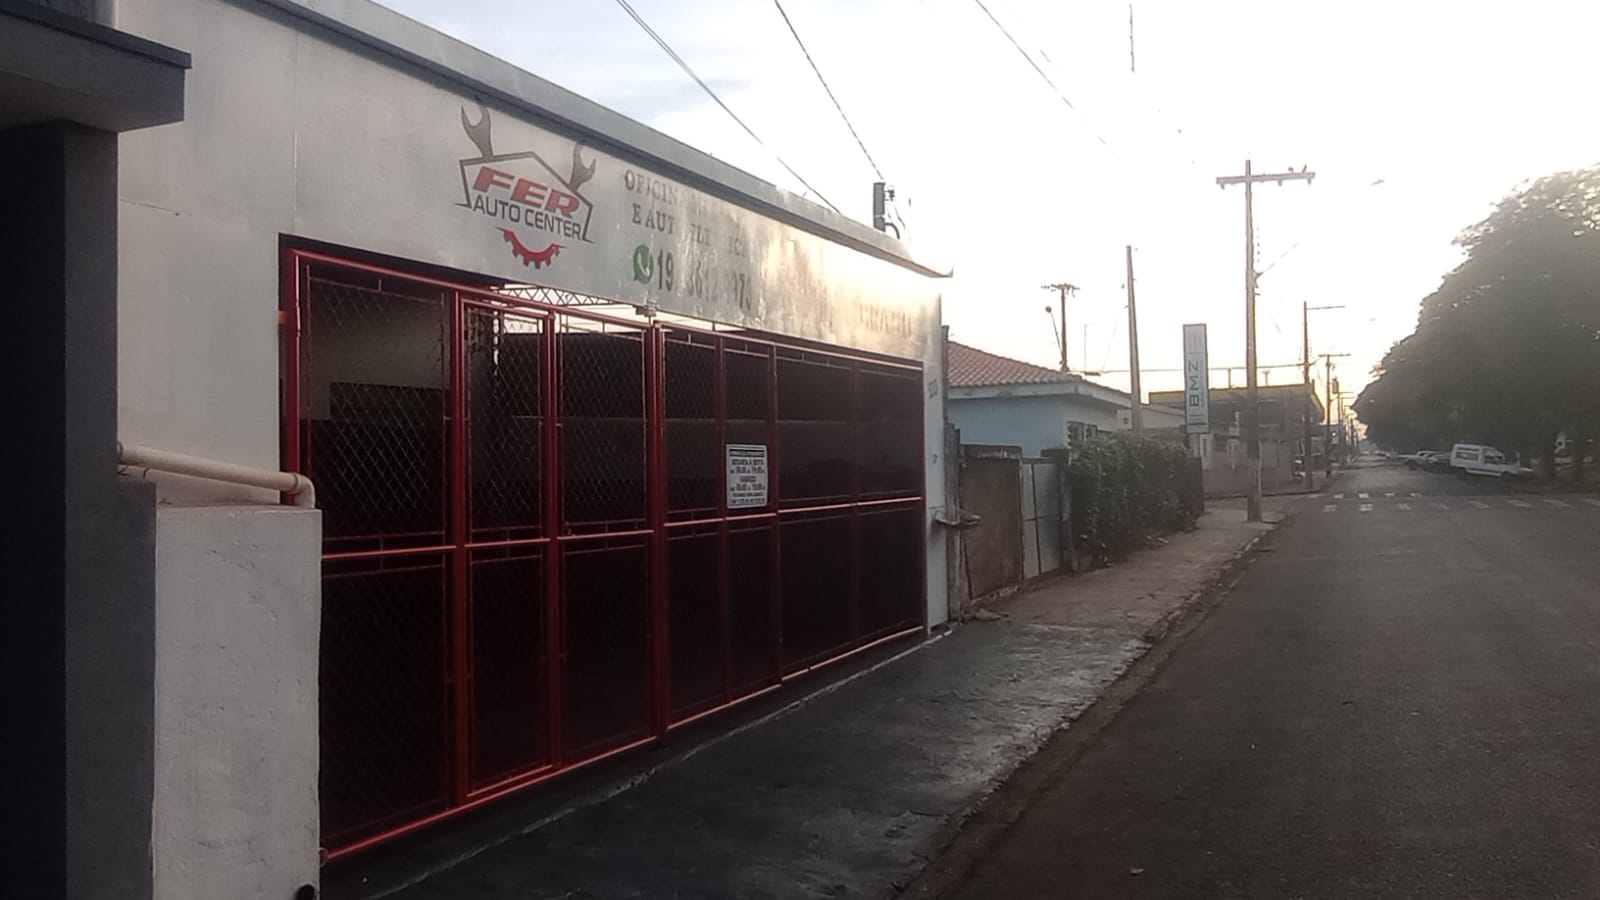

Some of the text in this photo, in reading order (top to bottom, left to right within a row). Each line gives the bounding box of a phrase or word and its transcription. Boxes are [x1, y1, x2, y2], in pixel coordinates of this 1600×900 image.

[473, 166, 580, 218] FER
[624, 169, 680, 206] OFICIN
[473, 194, 582, 240] AUTO CENTER
[632, 202, 642, 225] E
